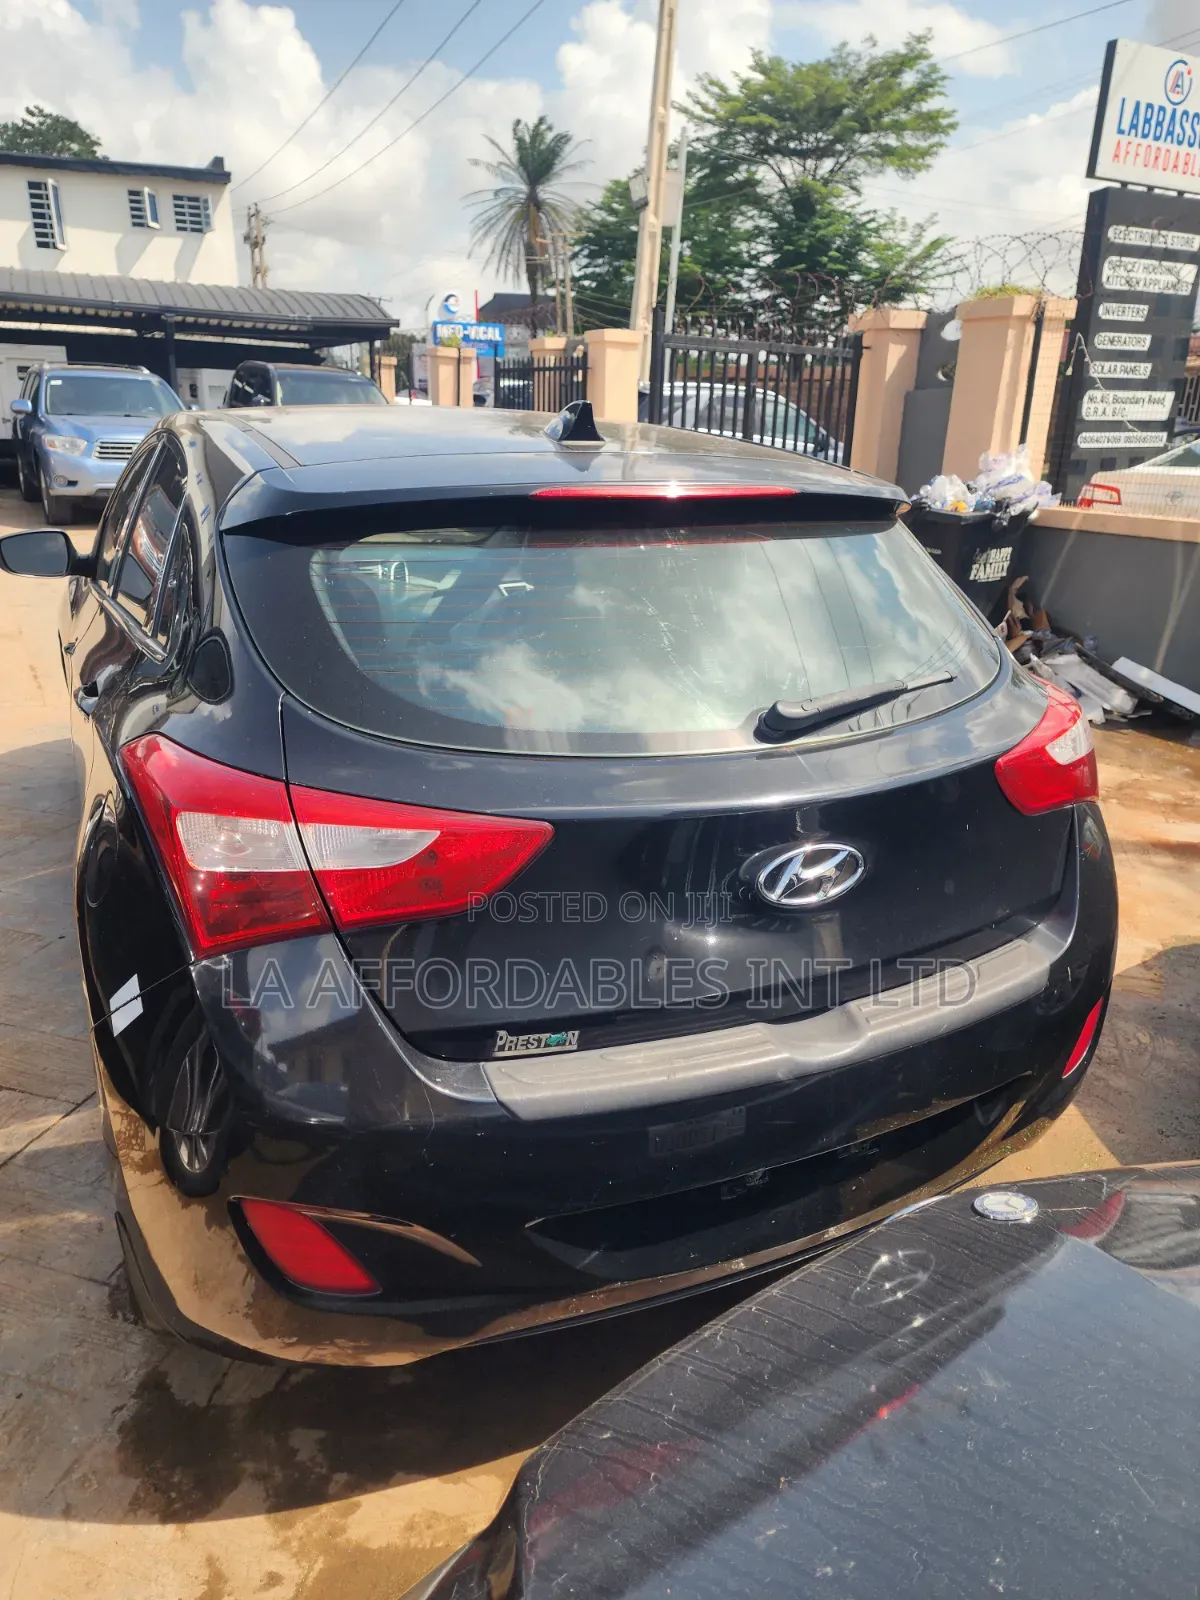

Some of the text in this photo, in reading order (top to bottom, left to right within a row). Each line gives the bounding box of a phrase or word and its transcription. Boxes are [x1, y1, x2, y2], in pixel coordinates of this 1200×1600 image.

[1116, 97, 1200, 148] LABBASS
[1112, 139, 1200, 178] AFFORDABL
[1102, 304, 1146, 318] INVERTERS
[1097, 334, 1147, 348] GENERATORS
[1092, 363, 1148, 376] SOLAR PANELS
[1112, 394, 1145, 408] Boundary
[969, 560, 1011, 581] FAMILY
